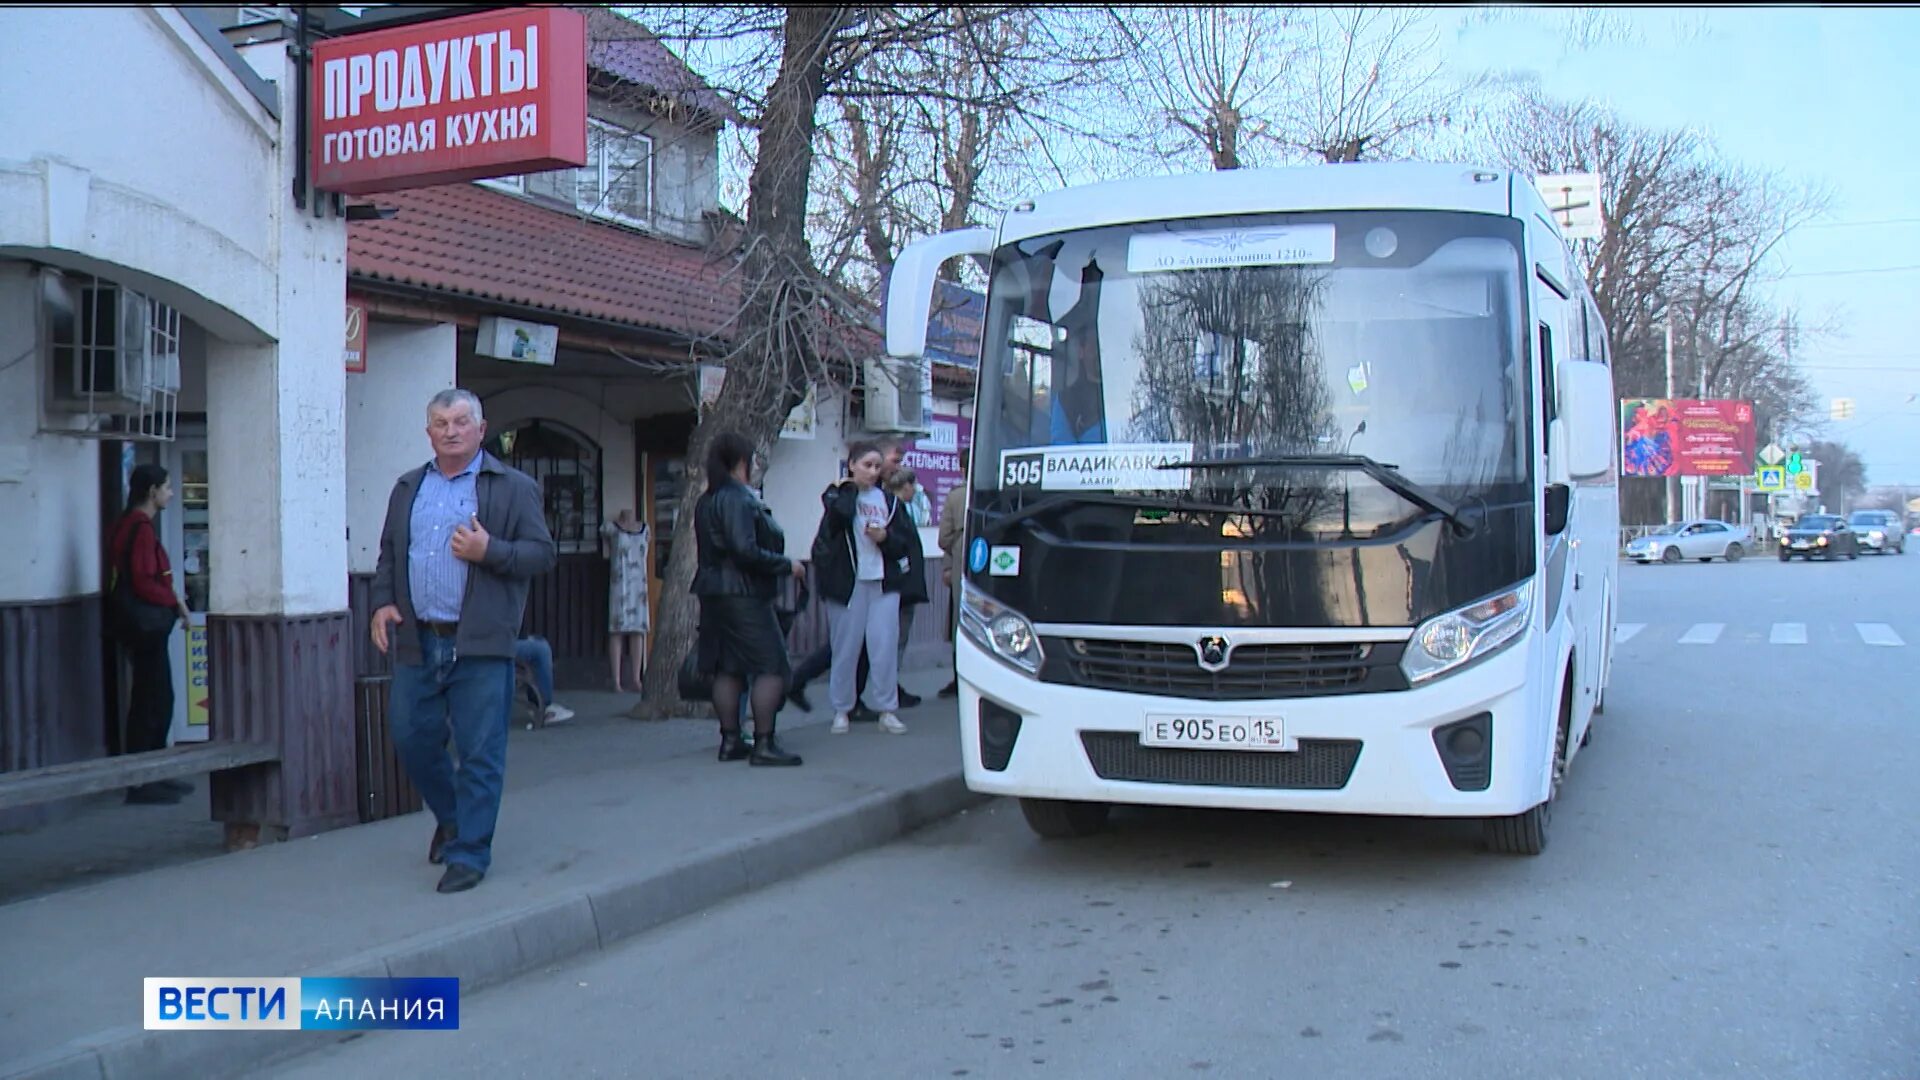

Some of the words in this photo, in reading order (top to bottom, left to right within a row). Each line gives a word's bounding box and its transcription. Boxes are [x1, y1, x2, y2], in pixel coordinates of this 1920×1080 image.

[324, 25, 538, 120] ПРОДУКТЫ
[323, 118, 436, 165] ГОТОВАЯ
[446, 103, 537, 148] КУХНЯ
[1155, 256, 1175, 267] АО
[1005, 460, 1041, 486] 305
[1080, 476, 1120, 486] АЛАГИР
[1253, 720, 1275, 737] 15
